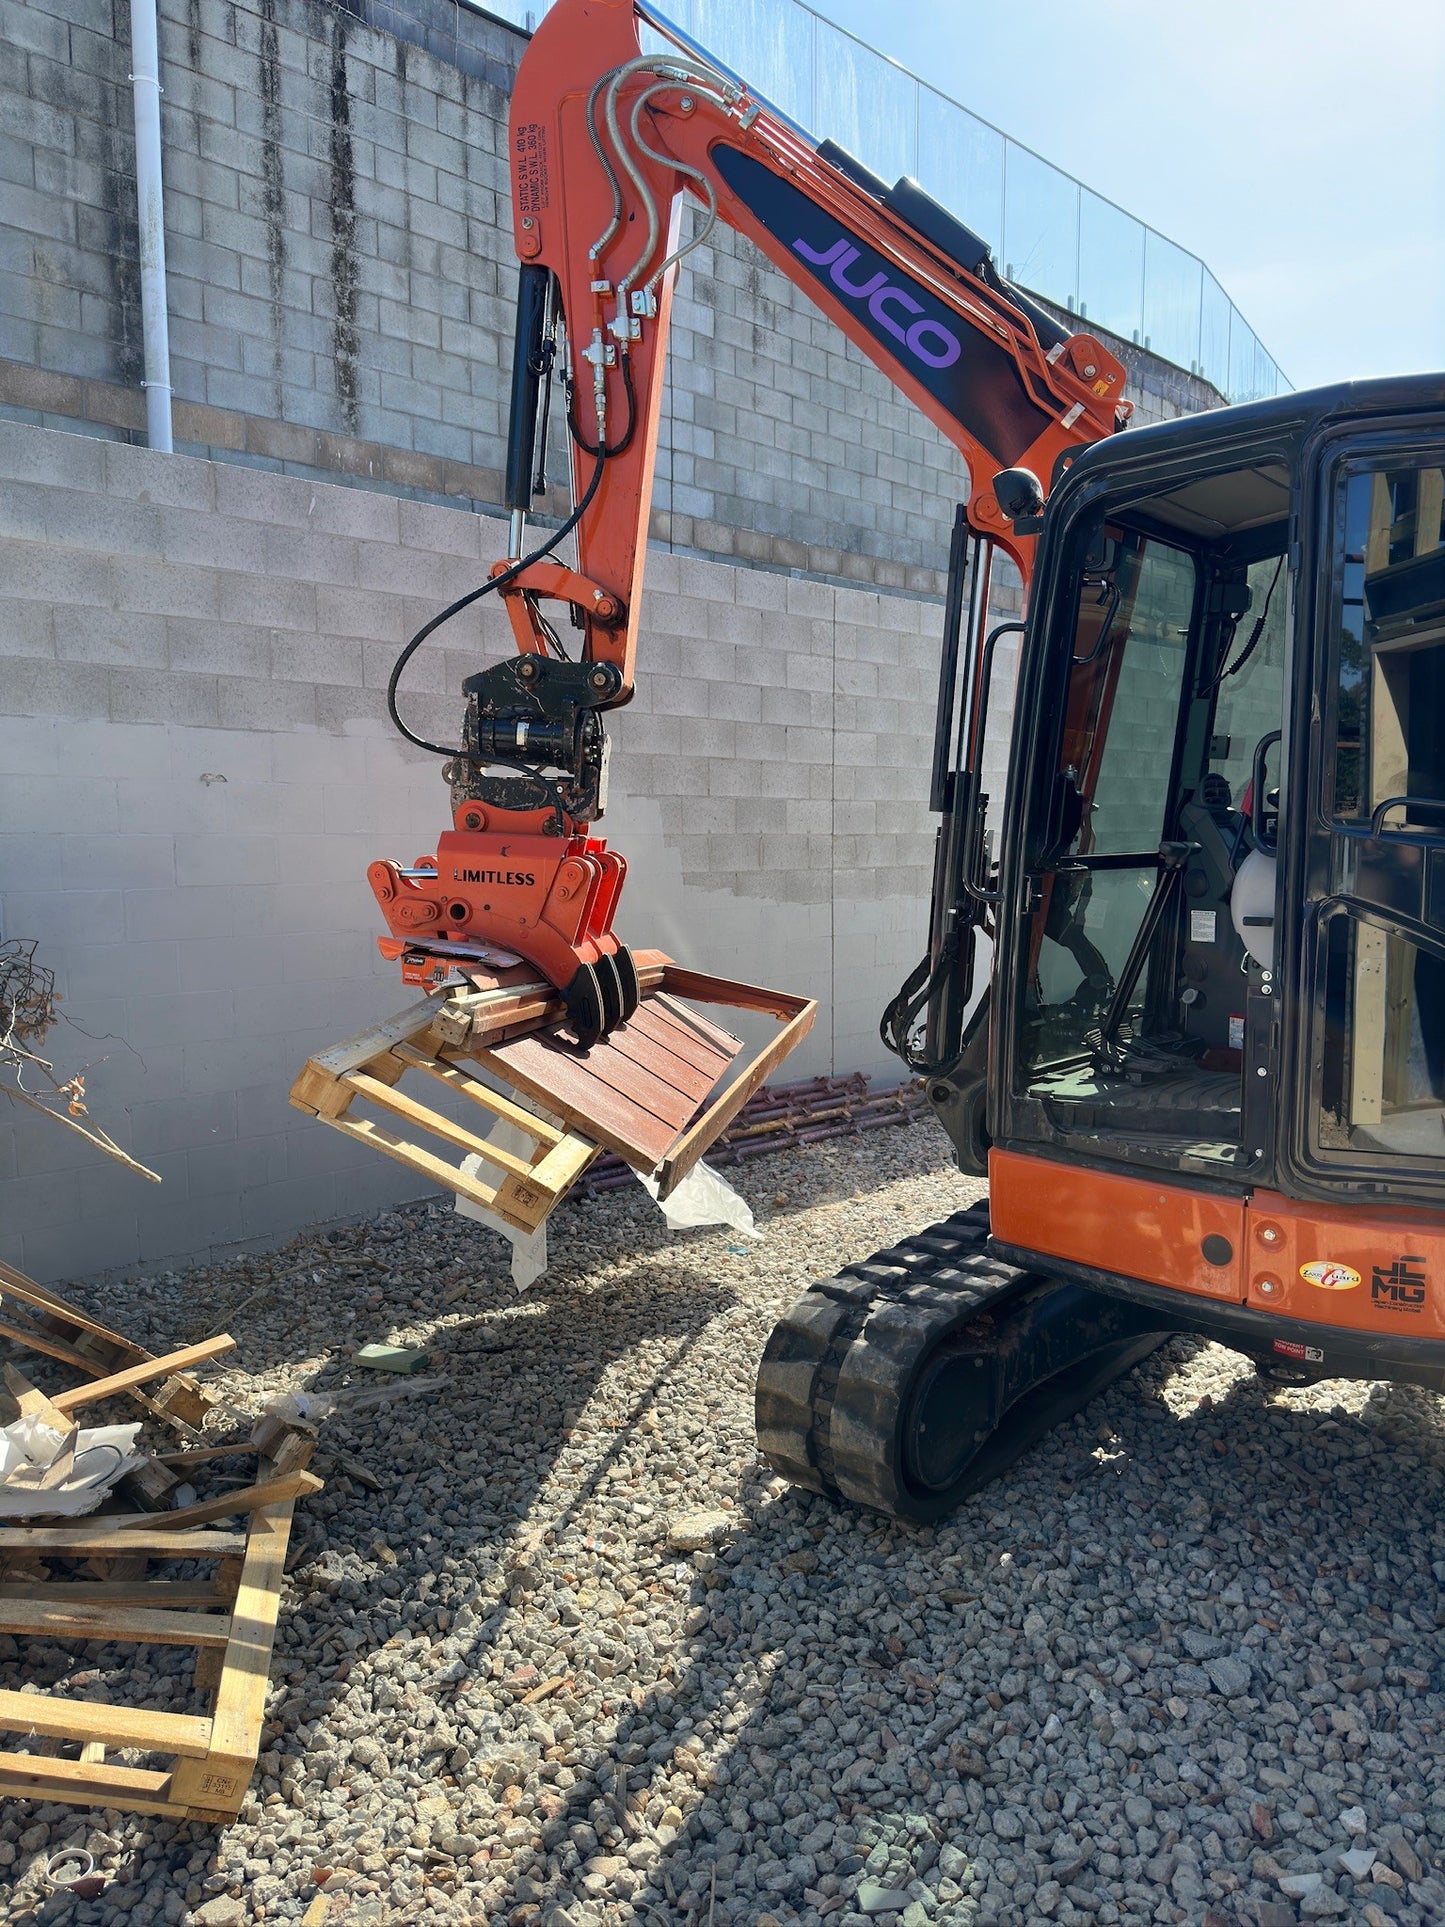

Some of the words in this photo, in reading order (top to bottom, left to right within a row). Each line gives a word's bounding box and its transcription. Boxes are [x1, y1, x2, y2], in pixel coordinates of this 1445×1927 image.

[517, 127, 527, 137] kg
[529, 124, 538, 133] kg
[517, 140, 525, 153] 410
[528, 135, 537, 150] 360
[519, 184, 529, 212] STATIC
[530, 178, 540, 212] DYNAMIC
[792, 238, 961, 368] JUCO
[453, 868, 535, 886] LIMITLESS
[1274, 1342, 1286, 1350] TOW
[1287, 1346, 1304, 1355] POINT
